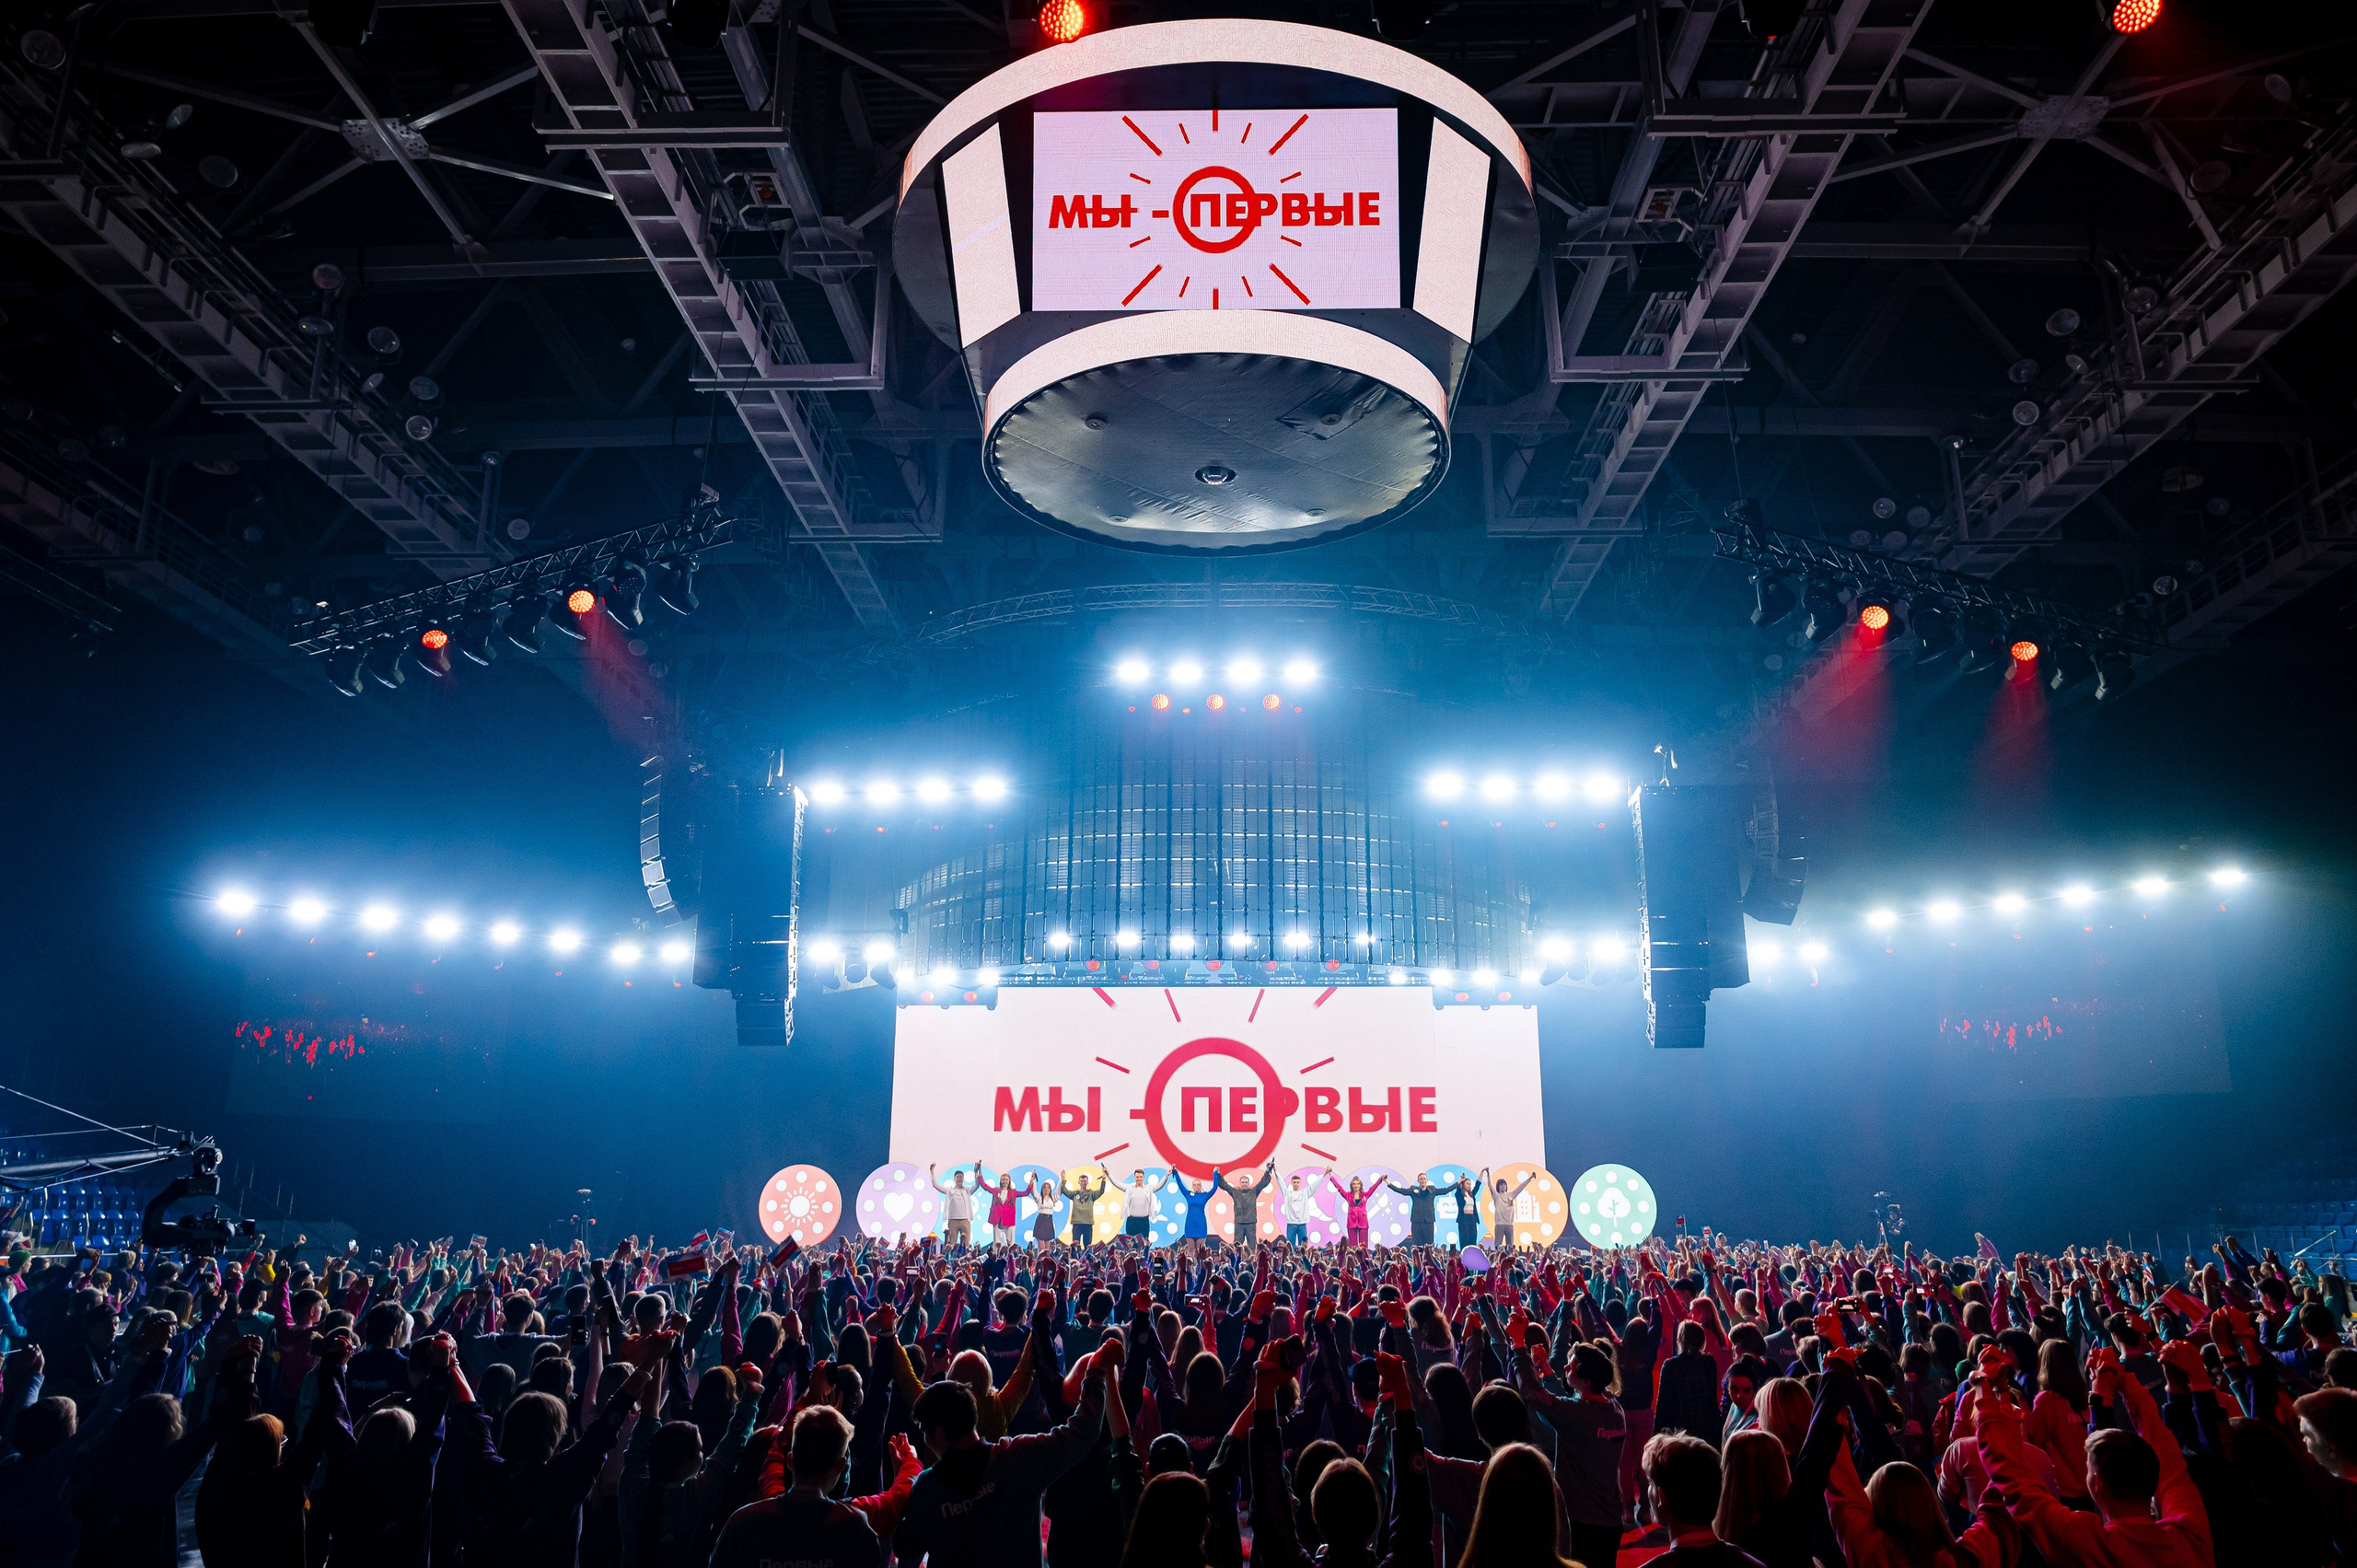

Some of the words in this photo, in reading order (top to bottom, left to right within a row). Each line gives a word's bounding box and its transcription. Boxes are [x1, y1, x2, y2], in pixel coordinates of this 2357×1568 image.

[1049, 194, 1139, 228] МЫ
[1190, 192, 1380, 227] ПЕРВЫЕ
[993, 1086, 1101, 1132] МЫ
[1181, 1086, 1438, 1132] ПЕРВЫЕ
[941, 1481, 996, 1519] Перые
